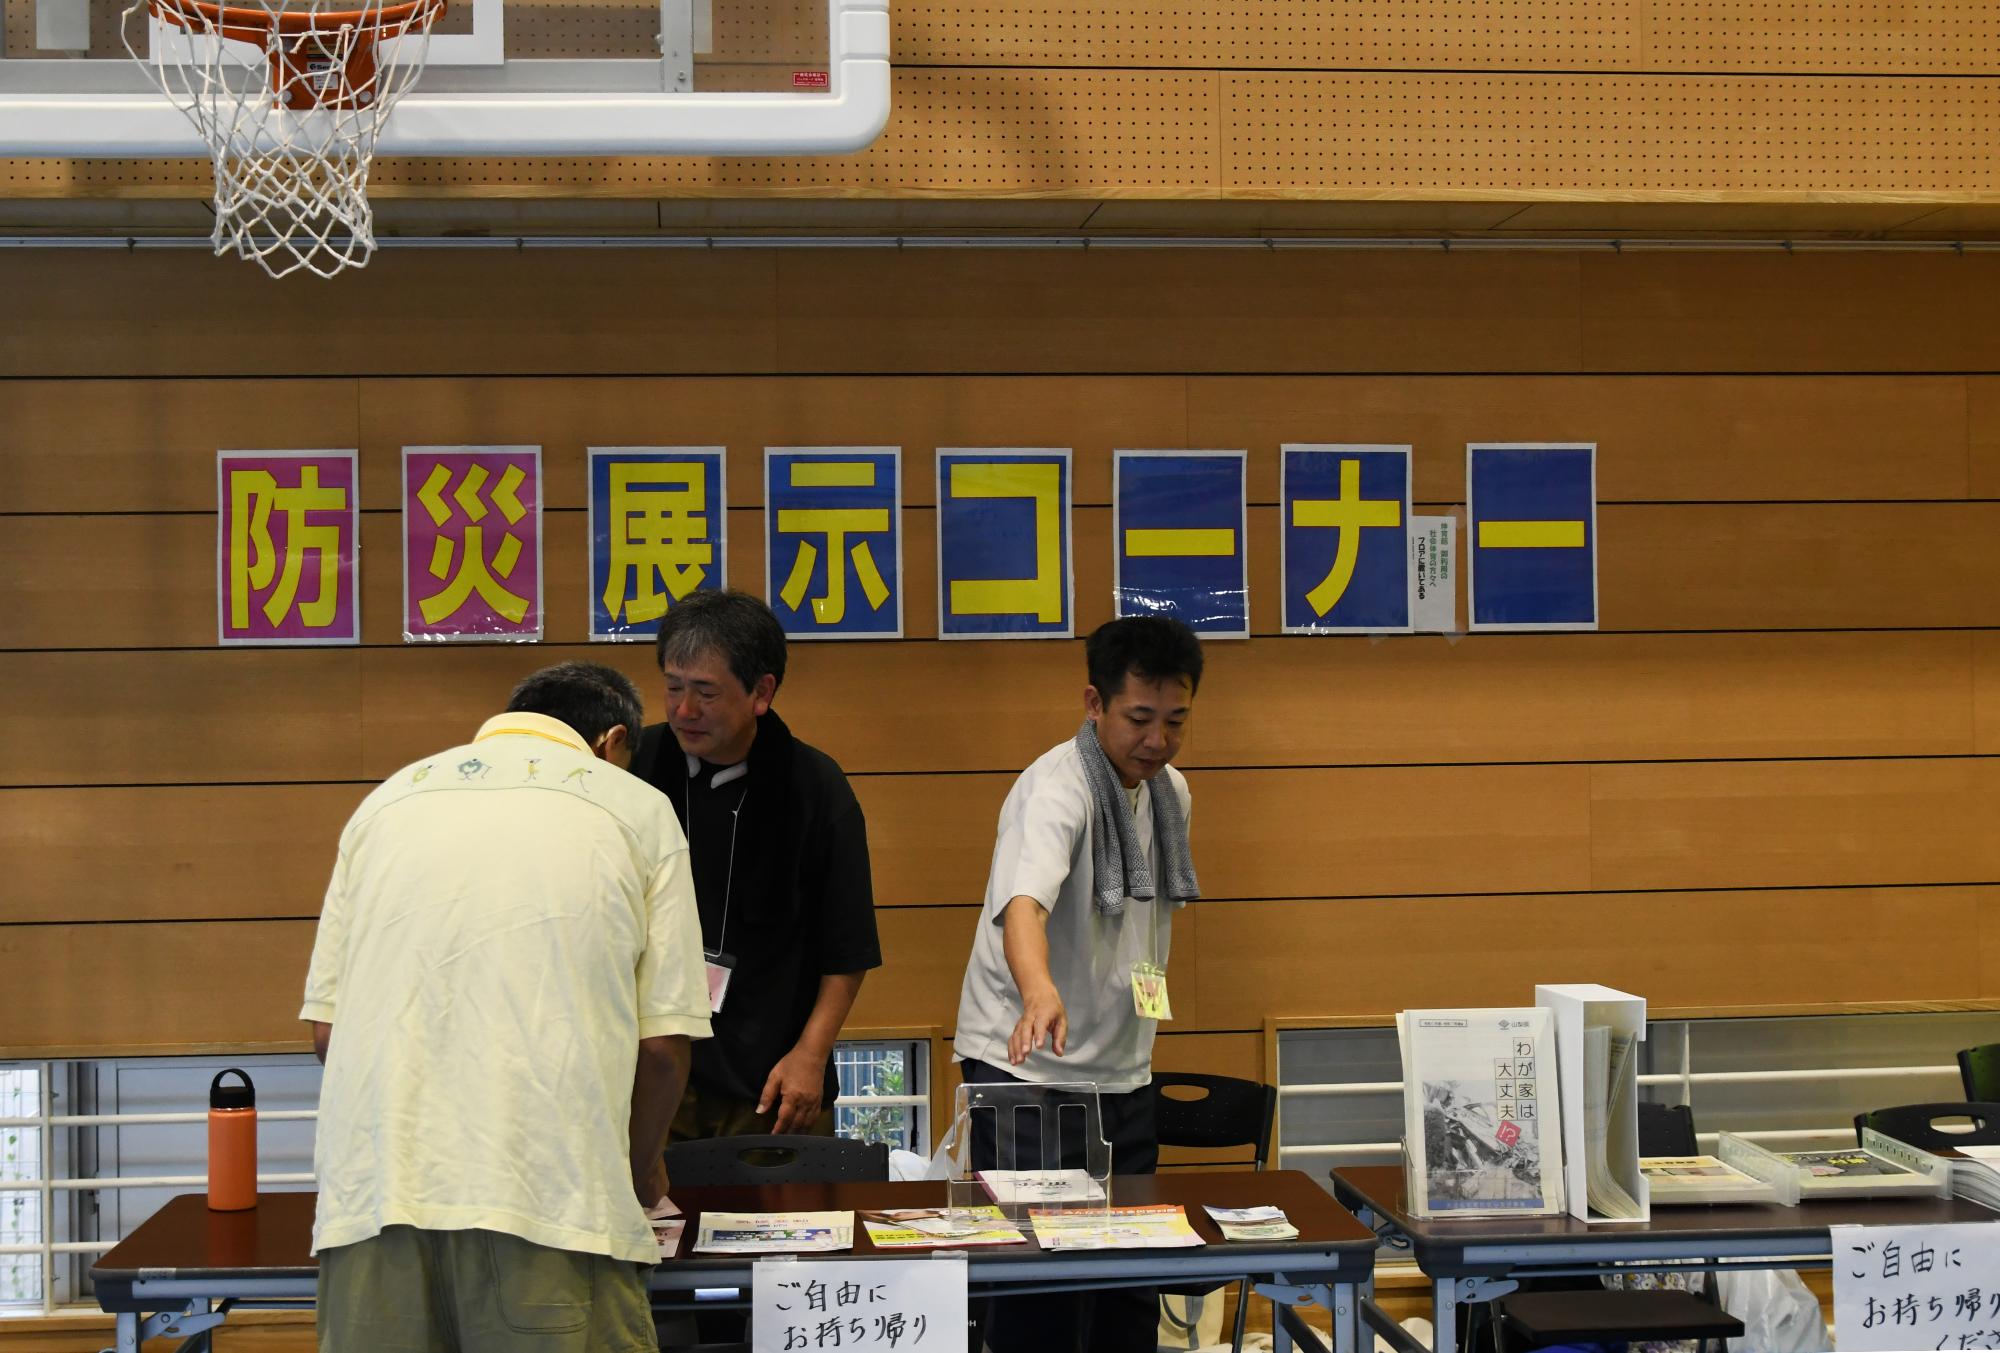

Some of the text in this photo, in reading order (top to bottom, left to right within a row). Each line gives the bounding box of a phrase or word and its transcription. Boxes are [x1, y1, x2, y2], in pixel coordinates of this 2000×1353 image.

[230, 460, 1584, 628] 防災展示コーナー
[1497, 1062, 1515, 1119] 大丈夫
[1516, 1041, 1534, 1119] わが家は
[1852, 1240, 1962, 1278] ご自由に
[776, 1279, 887, 1312] ご自由に
[1862, 1287, 2000, 1329] お持ち帰り
[783, 1312, 927, 1351] お持ち帰り
